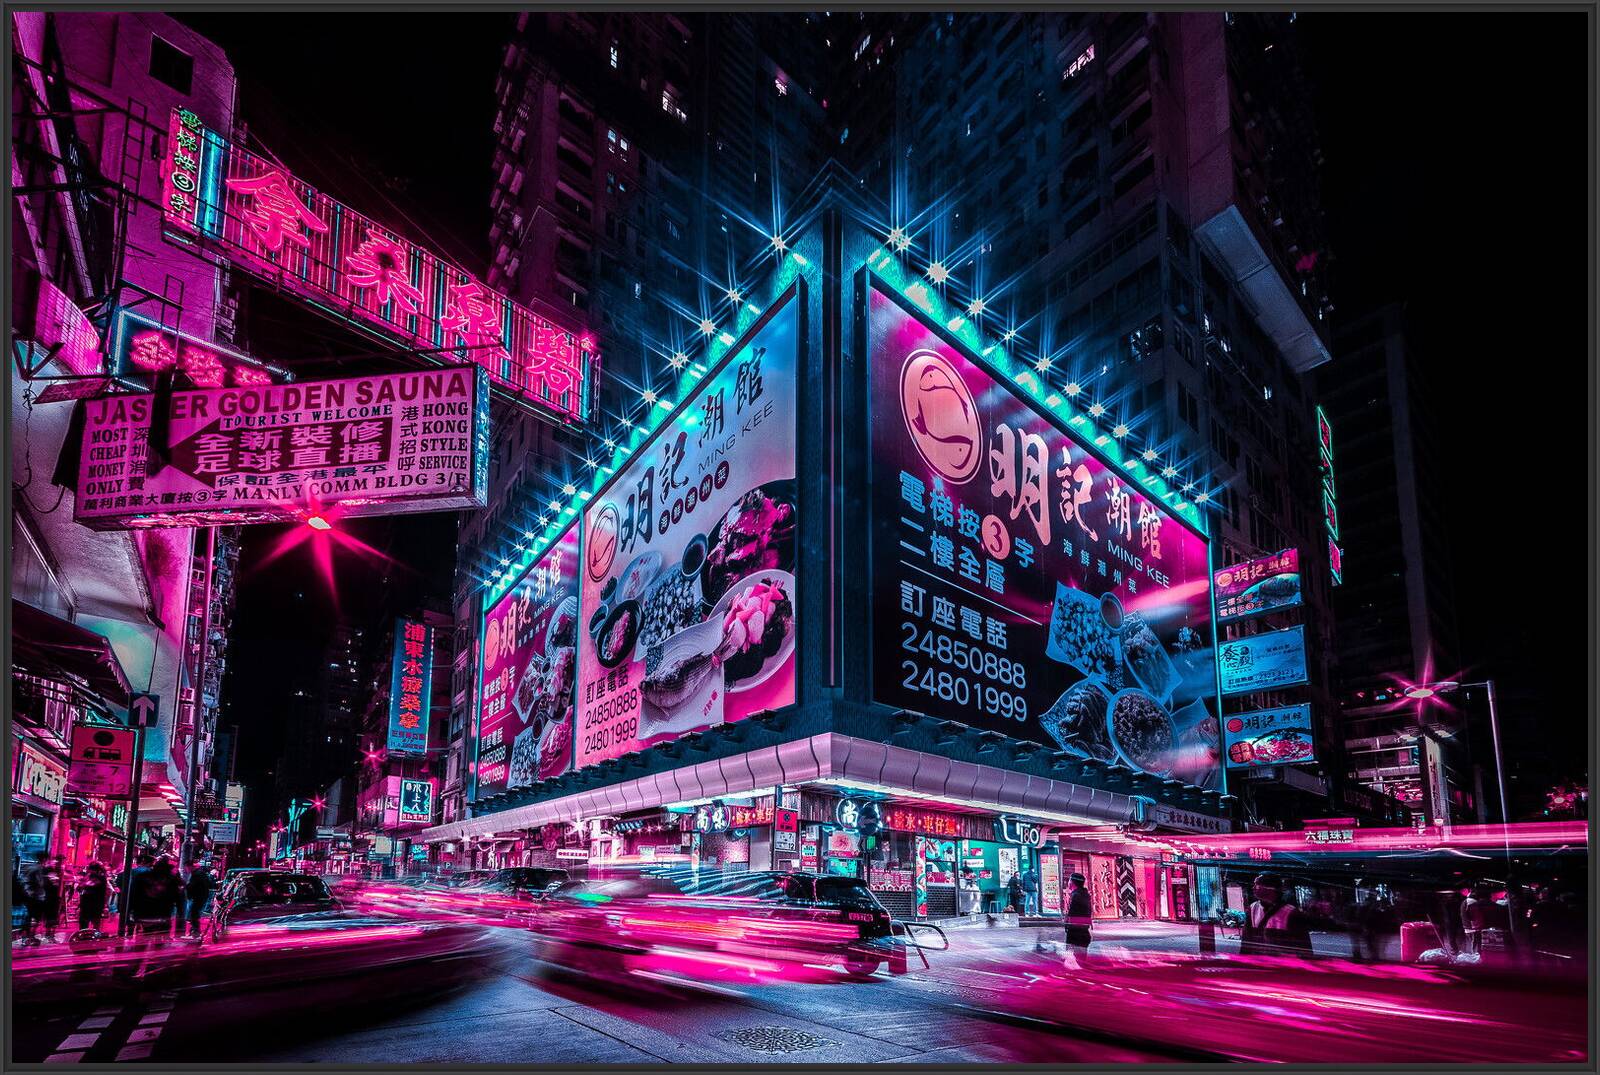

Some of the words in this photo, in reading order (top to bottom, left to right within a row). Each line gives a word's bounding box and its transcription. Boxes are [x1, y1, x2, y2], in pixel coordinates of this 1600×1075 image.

[93, 394, 209, 425] JASER
[218, 383, 346, 417] GOLDEN
[355, 373, 467, 405] SAUNA
[422, 402, 469, 417] HONG
[224, 412, 303, 429] TOURIST
[312, 405, 393, 422] WELCOME
[421, 419, 469, 435] KONG
[92, 427, 129, 444] MOST
[194, 420, 384, 454] 全新裝修
[397, 405, 419, 471] 港式招呼
[420, 437, 468, 452] STYLE
[698, 433, 736, 475] MING
[742, 399, 774, 437] KEE
[90, 444, 127, 462] CHEAP
[193, 443, 383, 475] 足球直播
[418, 455, 467, 470] SERVICE
[88, 461, 125, 479] MONEY
[233, 484, 303, 500] MANLY
[309, 478, 368, 495] COMM
[375, 473, 428, 489] BLDG
[435, 471, 467, 488] 3/F
[86, 479, 123, 496] ONLY
[989, 423, 1162, 560] 明記潮館
[1107, 539, 1143, 572] MING
[1147, 567, 1171, 590] KEE
[900, 580, 1007, 650] 訂座電話
[902, 621, 1026, 689] 24850888
[585, 662, 629, 705] 訂座電話
[902, 660, 1028, 722] 24801999
[585, 688, 638, 730] 24850888
[584, 717, 638, 755] 24801999
[1304, 829, 1354, 841] 六福珠寶
